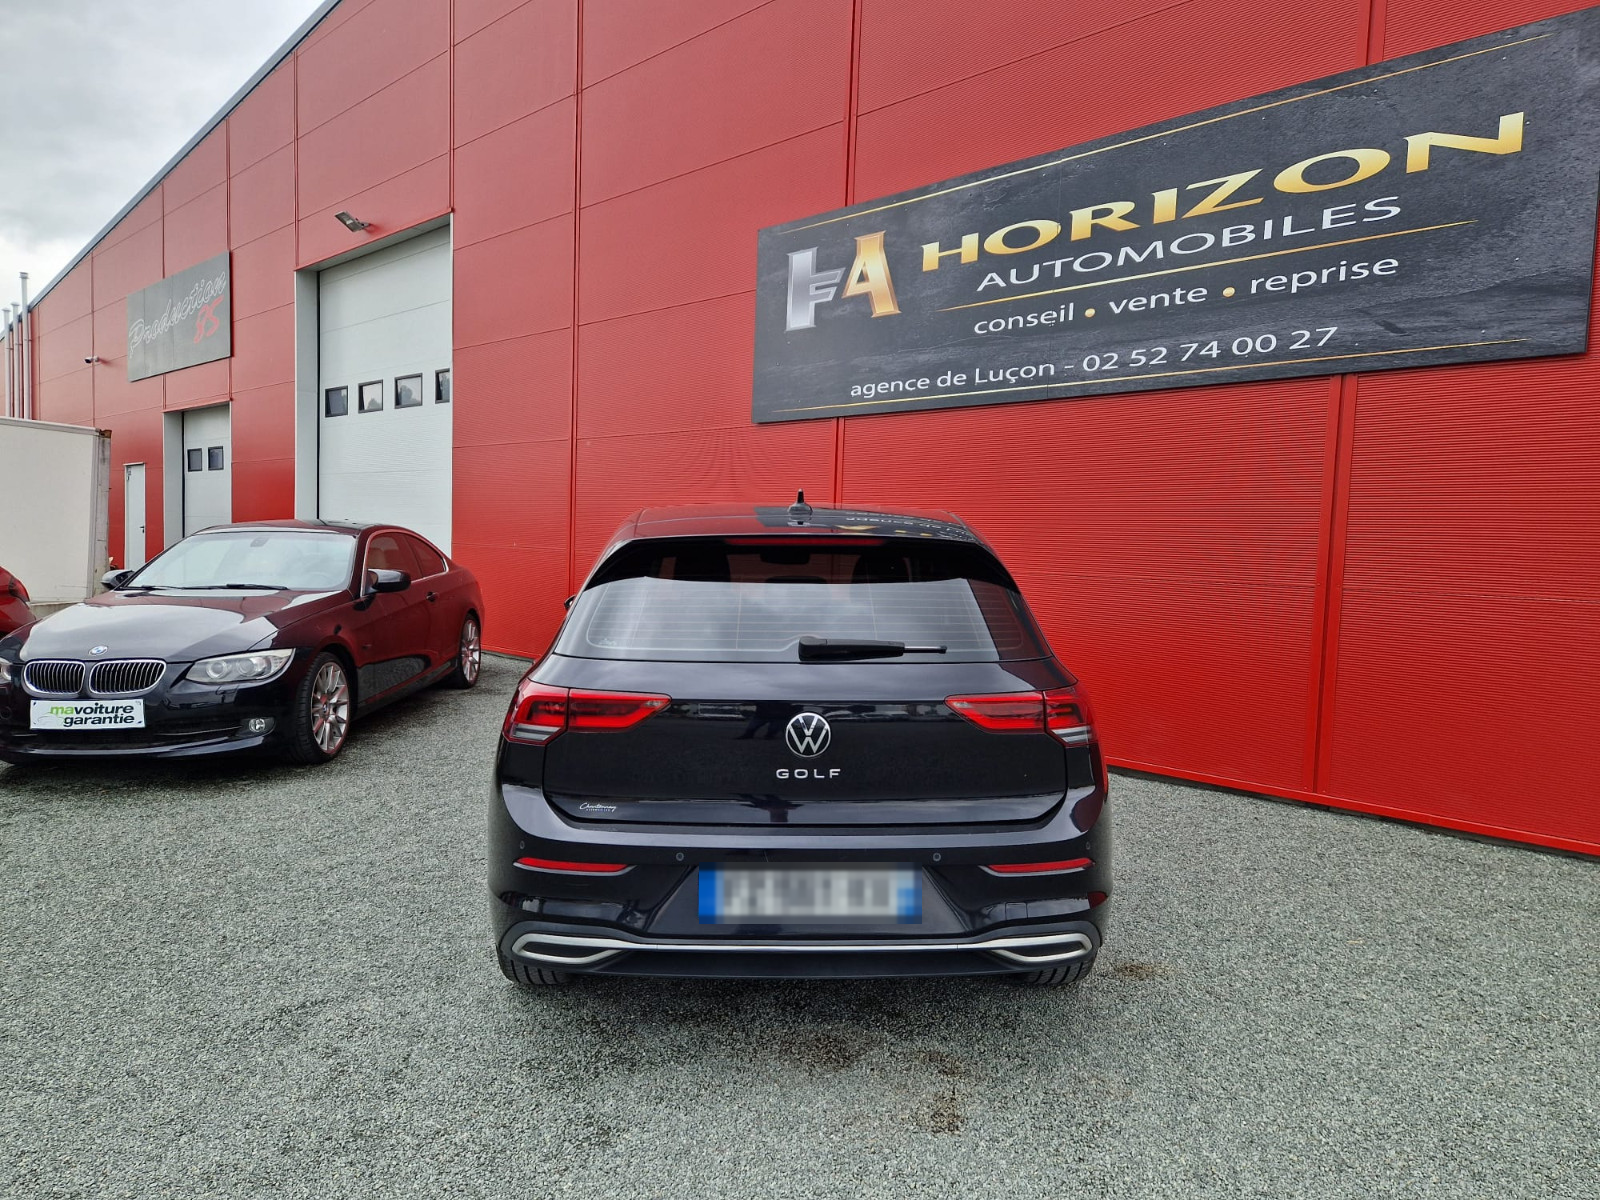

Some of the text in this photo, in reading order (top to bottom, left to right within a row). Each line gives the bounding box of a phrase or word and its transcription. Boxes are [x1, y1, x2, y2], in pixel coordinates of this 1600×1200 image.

[921, 111, 1524, 272] HORIZON
[976, 196, 1401, 292] AUTOMOBILES
[974, 258, 1399, 334] conseil vente reprise
[850, 376, 930, 398] agence
[936, 371, 967, 387] de
[975, 362, 1055, 385] Luçon
[1082, 353, 1119, 371] 02
[1129, 347, 1167, 367] 52
[1180, 340, 1221, 362] 74
[1231, 333, 1277, 355] 00
[1289, 327, 1338, 350] 27
[63, 713, 135, 727] garantie
[776, 768, 841, 779] GOLF
